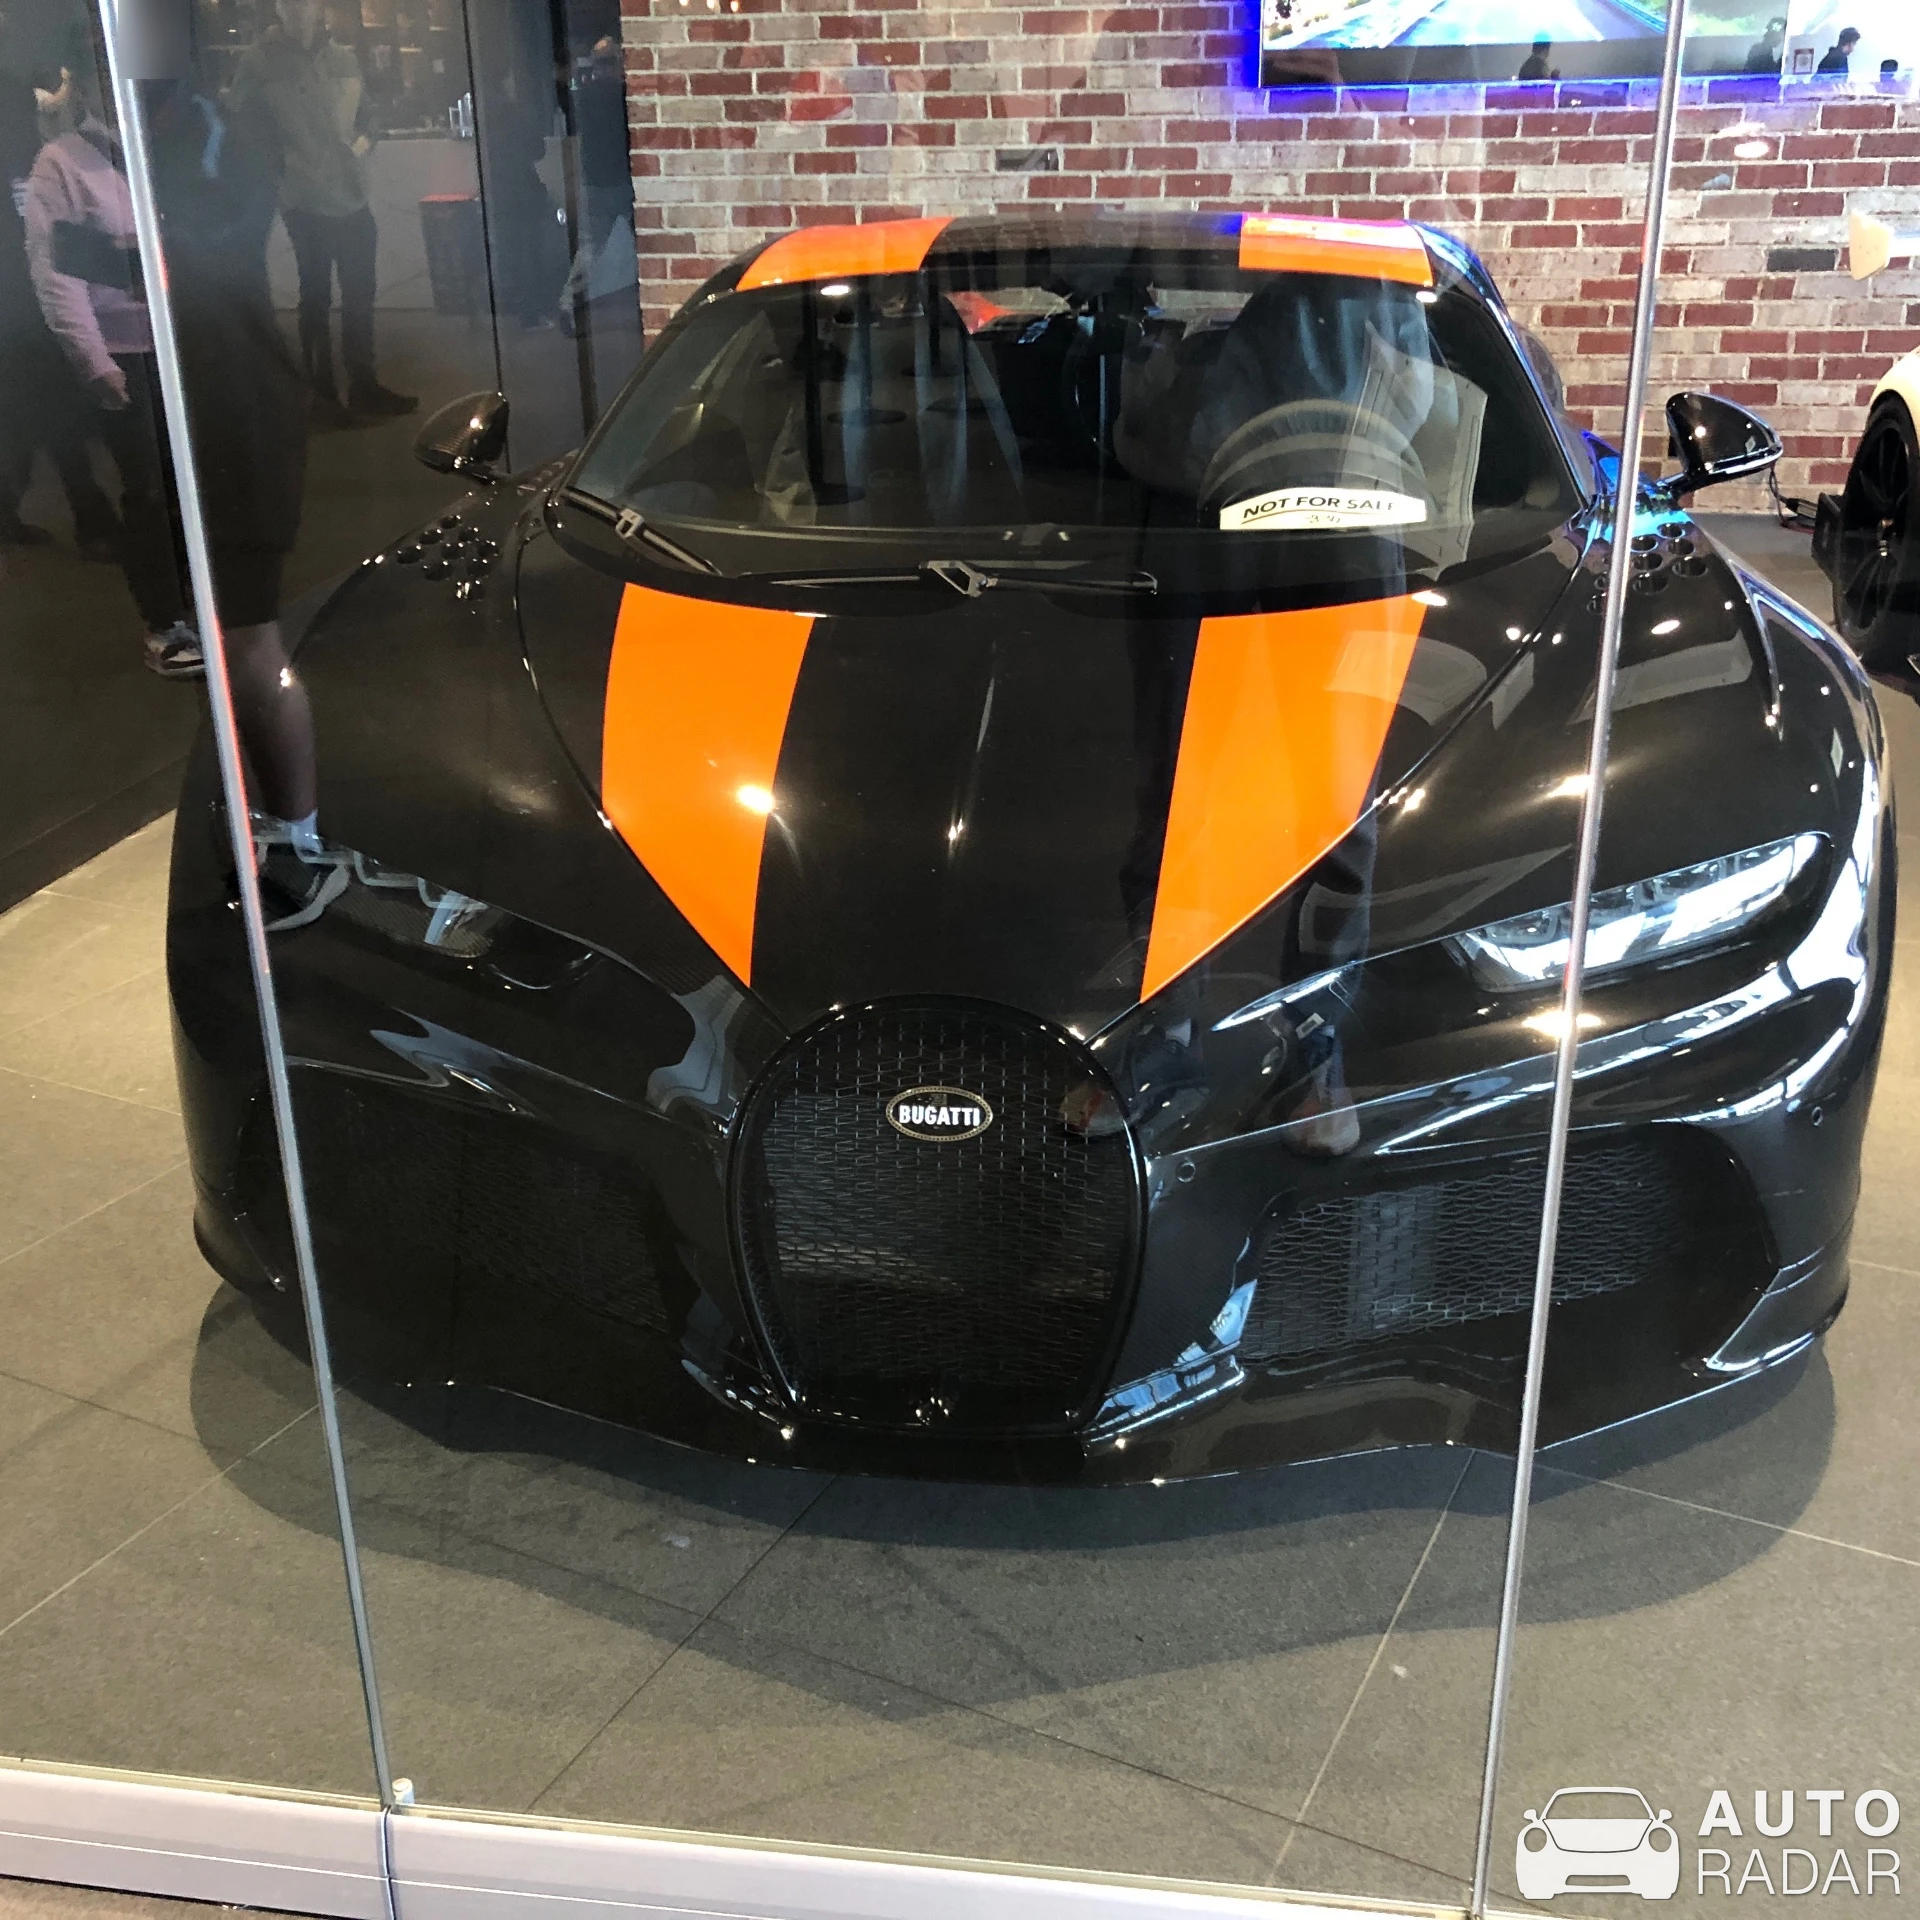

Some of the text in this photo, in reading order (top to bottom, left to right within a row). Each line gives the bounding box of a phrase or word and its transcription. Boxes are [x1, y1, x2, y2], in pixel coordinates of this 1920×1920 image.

[1243, 497, 1291, 518] NOT
[1296, 496, 1340, 508] FOR
[899, 1105, 980, 1126] BUGATTI
